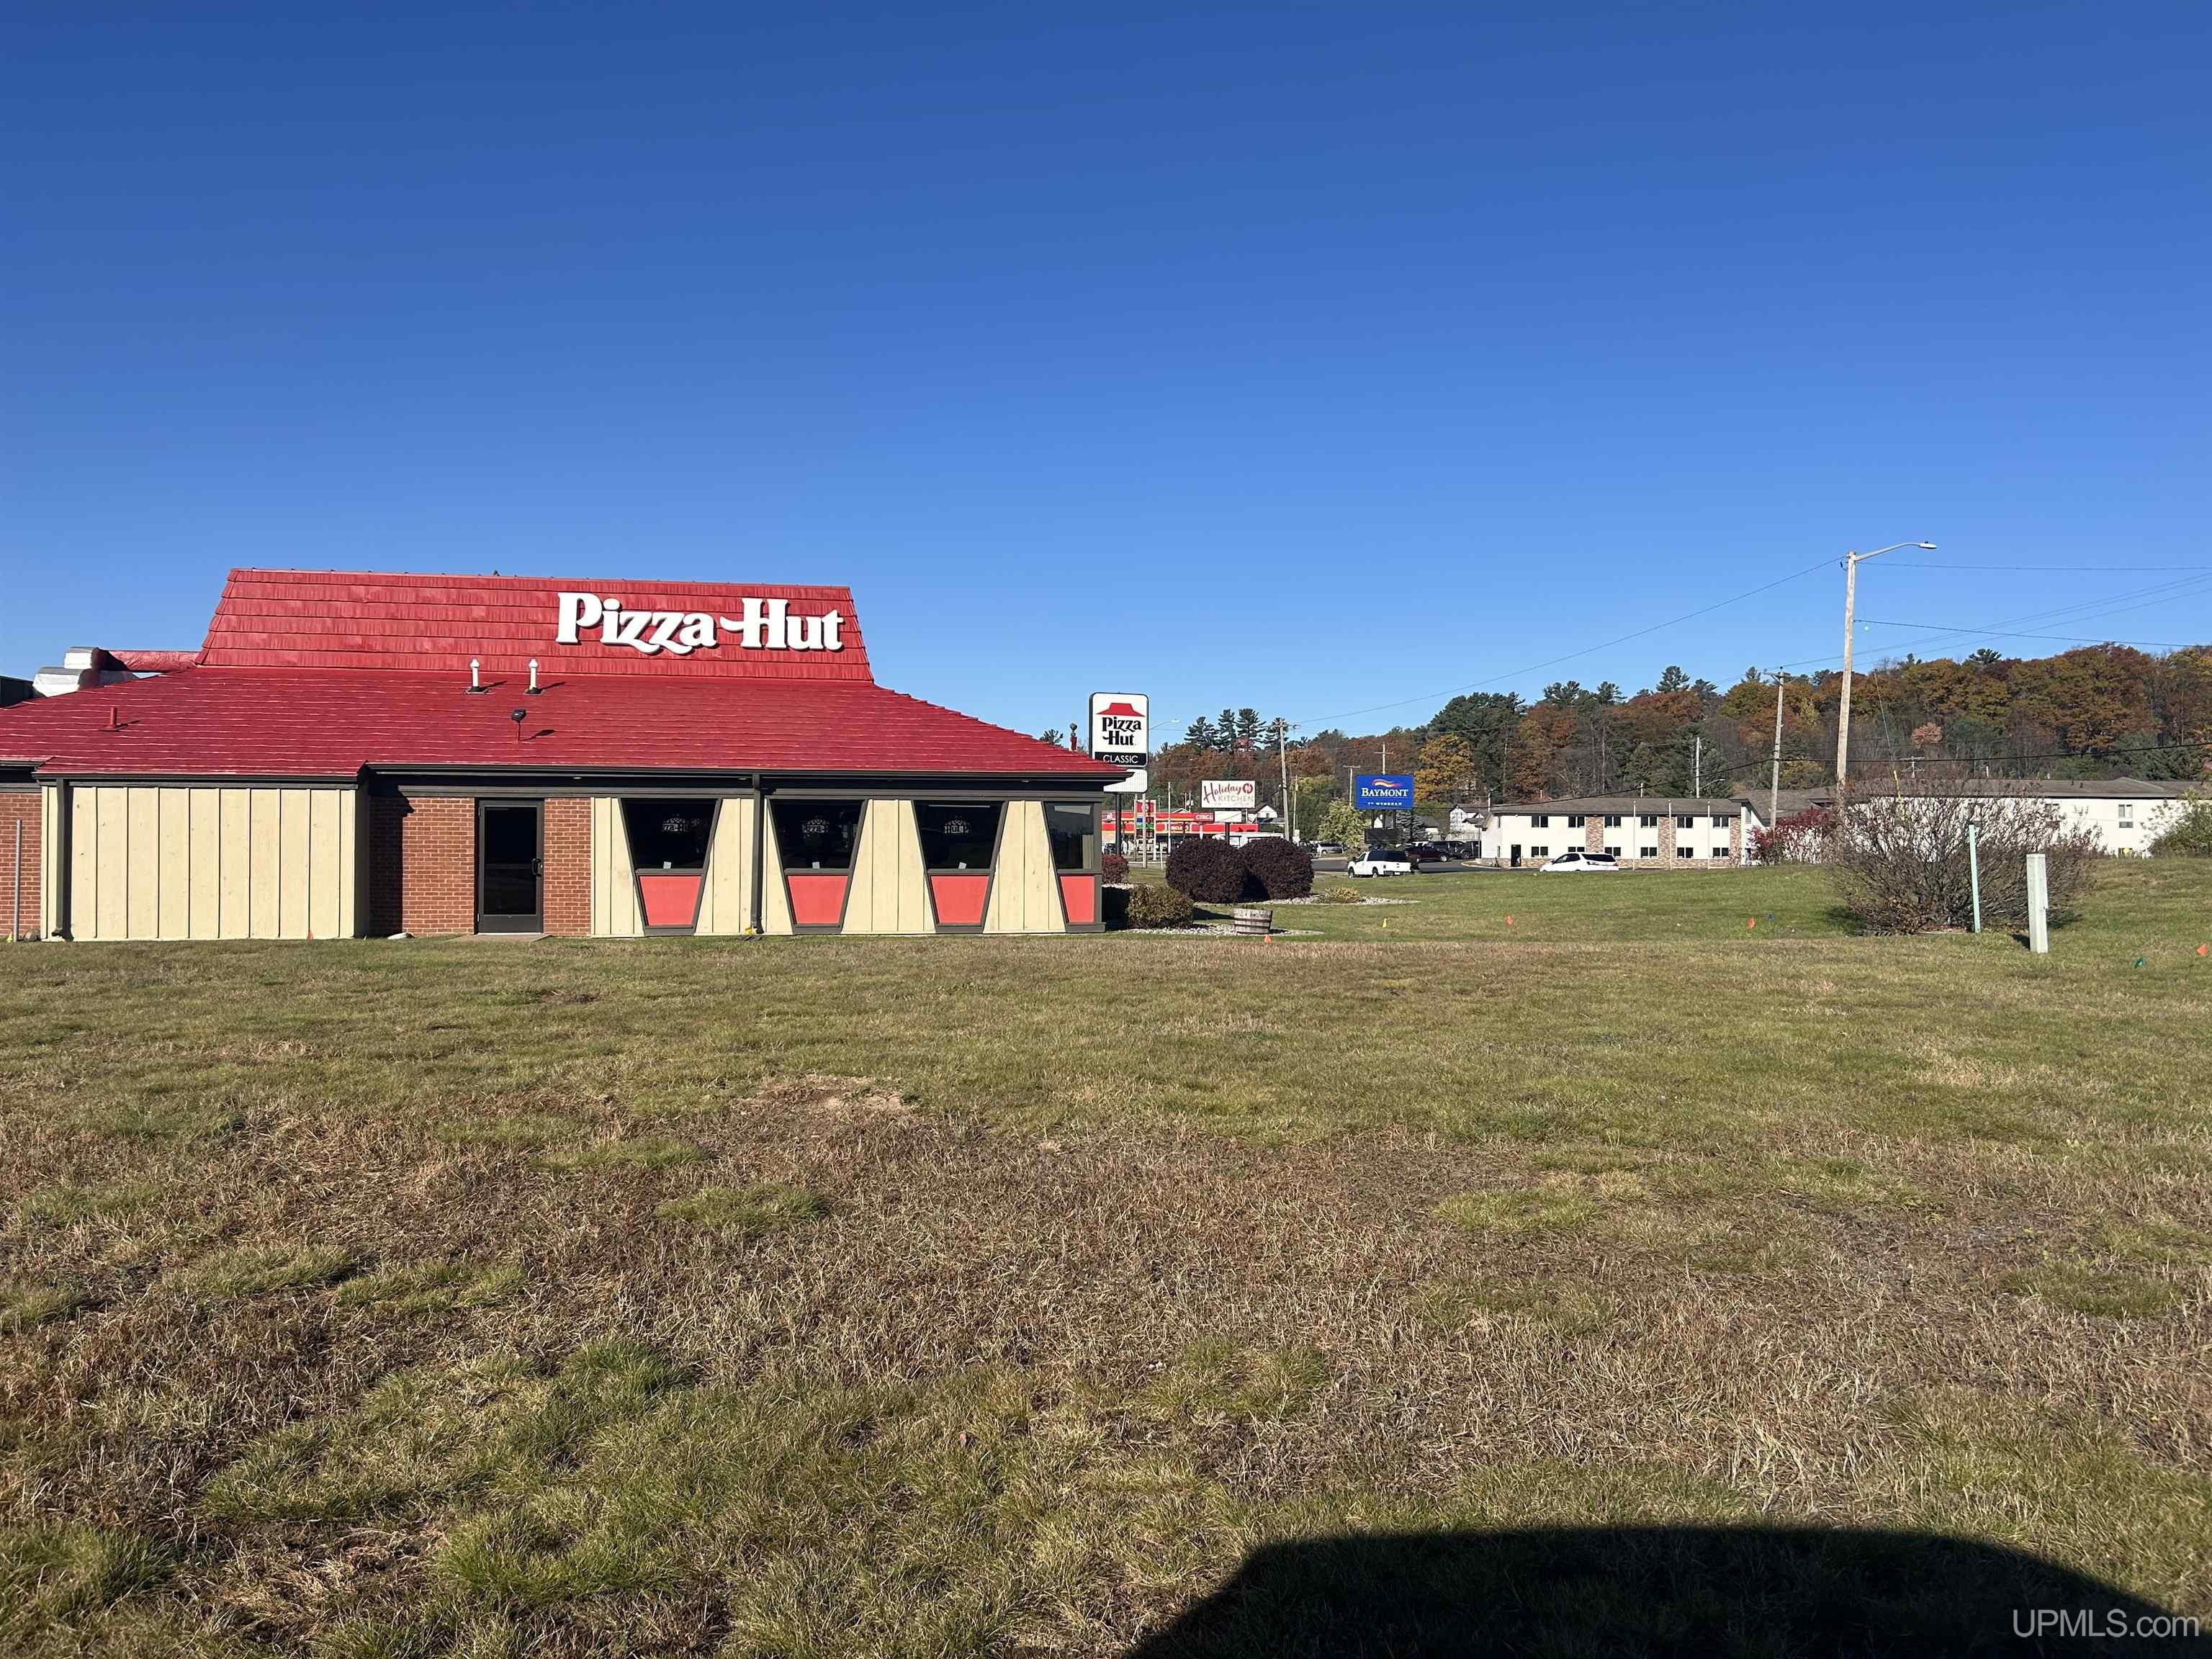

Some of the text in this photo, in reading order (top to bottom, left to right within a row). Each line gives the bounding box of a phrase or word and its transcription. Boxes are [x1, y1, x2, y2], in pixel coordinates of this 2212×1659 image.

[555, 592, 845, 655] Pizza Hut
[1102, 716, 1142, 733] Pizza
[1102, 730, 1135, 746] Hut
[1102, 754, 1138, 764] CLASSIC
[1203, 782, 1241, 804] Holiday
[1361, 787, 1408, 797] BAYMONT
